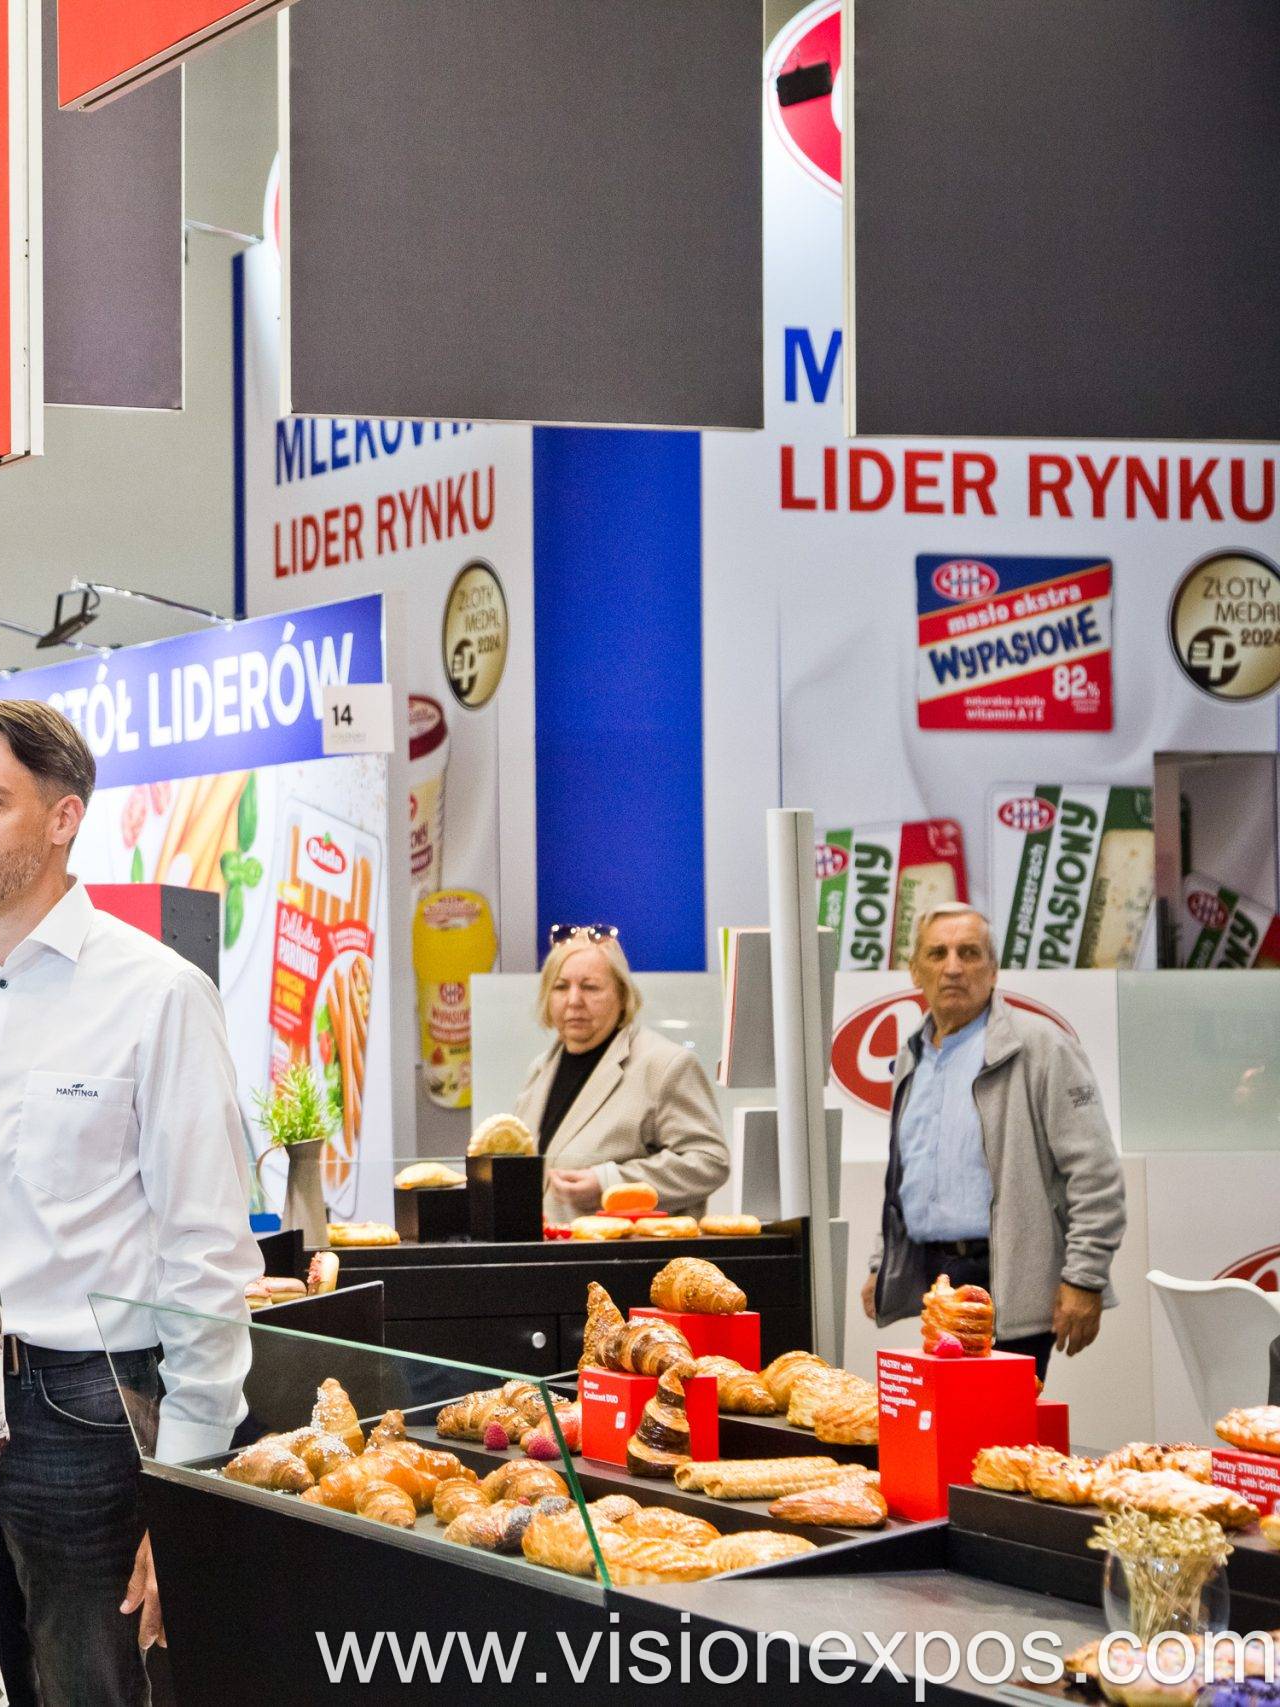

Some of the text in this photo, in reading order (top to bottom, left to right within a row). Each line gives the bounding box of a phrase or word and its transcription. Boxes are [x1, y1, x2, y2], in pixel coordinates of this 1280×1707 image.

[779, 445, 1276, 523] LIDER RYNKU
[274, 464, 496, 579] LIDER RYNKU
[947, 584, 1082, 636] masło ekstra
[147, 621, 354, 749] LIDERÓW
[331, 704, 354, 727] 14
[966, 707, 1016, 723] witamin
[850, 842, 893, 970] SIONY
[1037, 798, 1099, 969] PASIONY
[56, 1087, 99, 1098] MANTINGA
[1213, 1457, 1237, 1474] Pastry
[1213, 1471, 1237, 1485] STYLE
[1239, 1478, 1258, 1489] with
